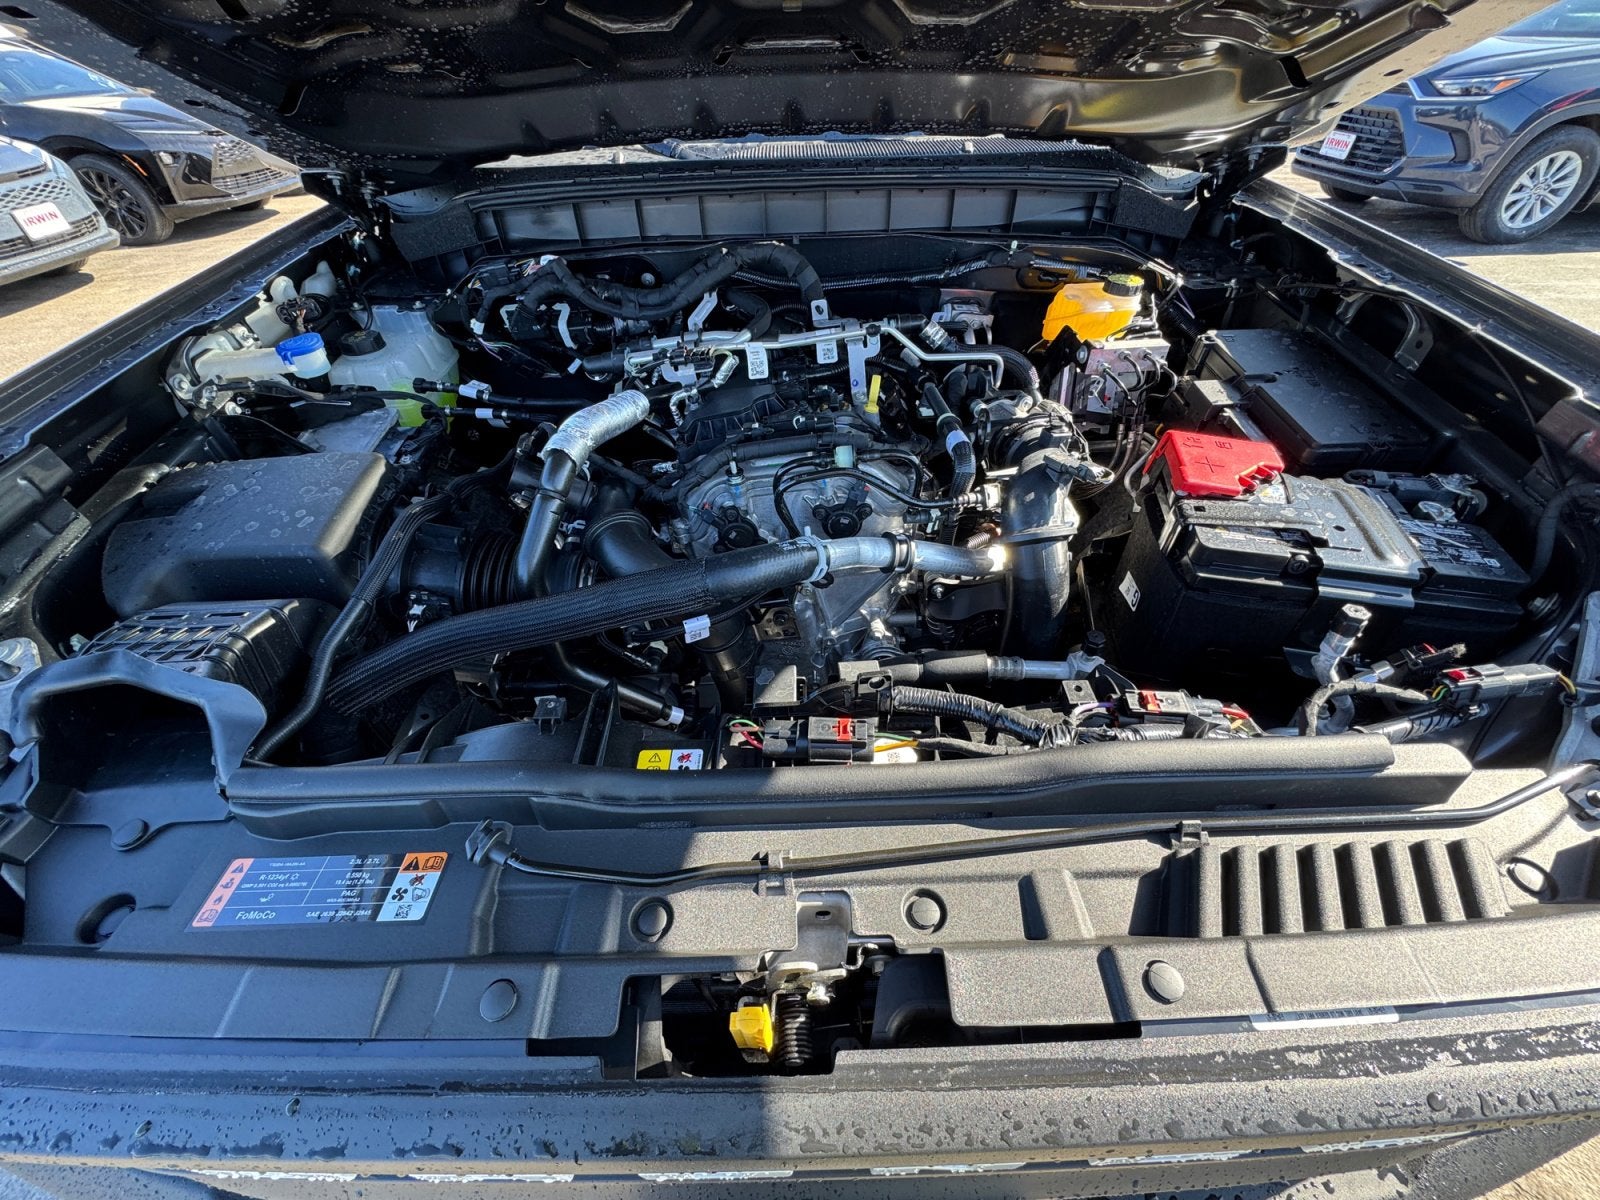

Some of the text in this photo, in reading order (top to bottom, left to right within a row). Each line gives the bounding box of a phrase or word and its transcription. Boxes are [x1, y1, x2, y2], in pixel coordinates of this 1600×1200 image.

[1326, 137, 1350, 149] IRWIN
[23, 211, 58, 226] IRWIN
[259, 873, 289, 881] R-1234yf
[362, 871, 370, 879] kg
[235, 910, 276, 920] FoMoCo
